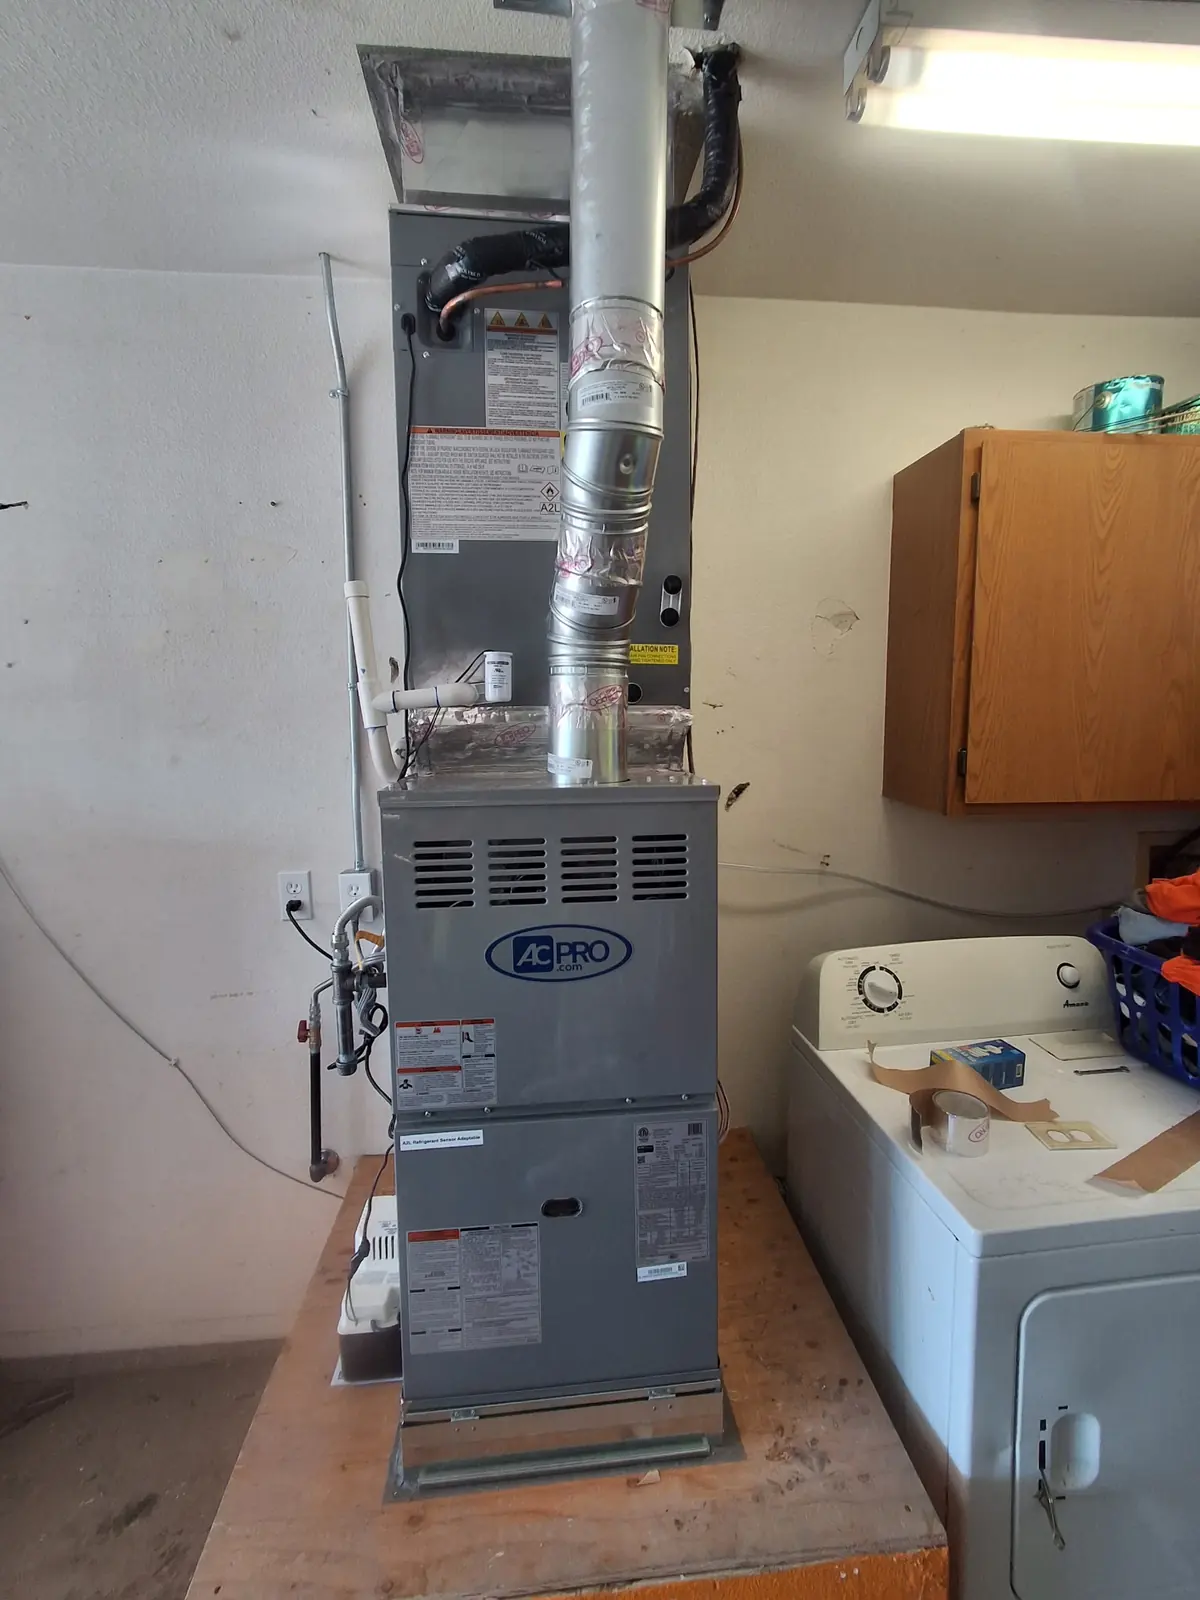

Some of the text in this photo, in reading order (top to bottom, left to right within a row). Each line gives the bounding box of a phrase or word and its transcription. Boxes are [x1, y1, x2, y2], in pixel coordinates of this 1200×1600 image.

[540, 503, 561, 512] A2L
[556, 939, 611, 965] PRO
[556, 963, 583, 972] .com
